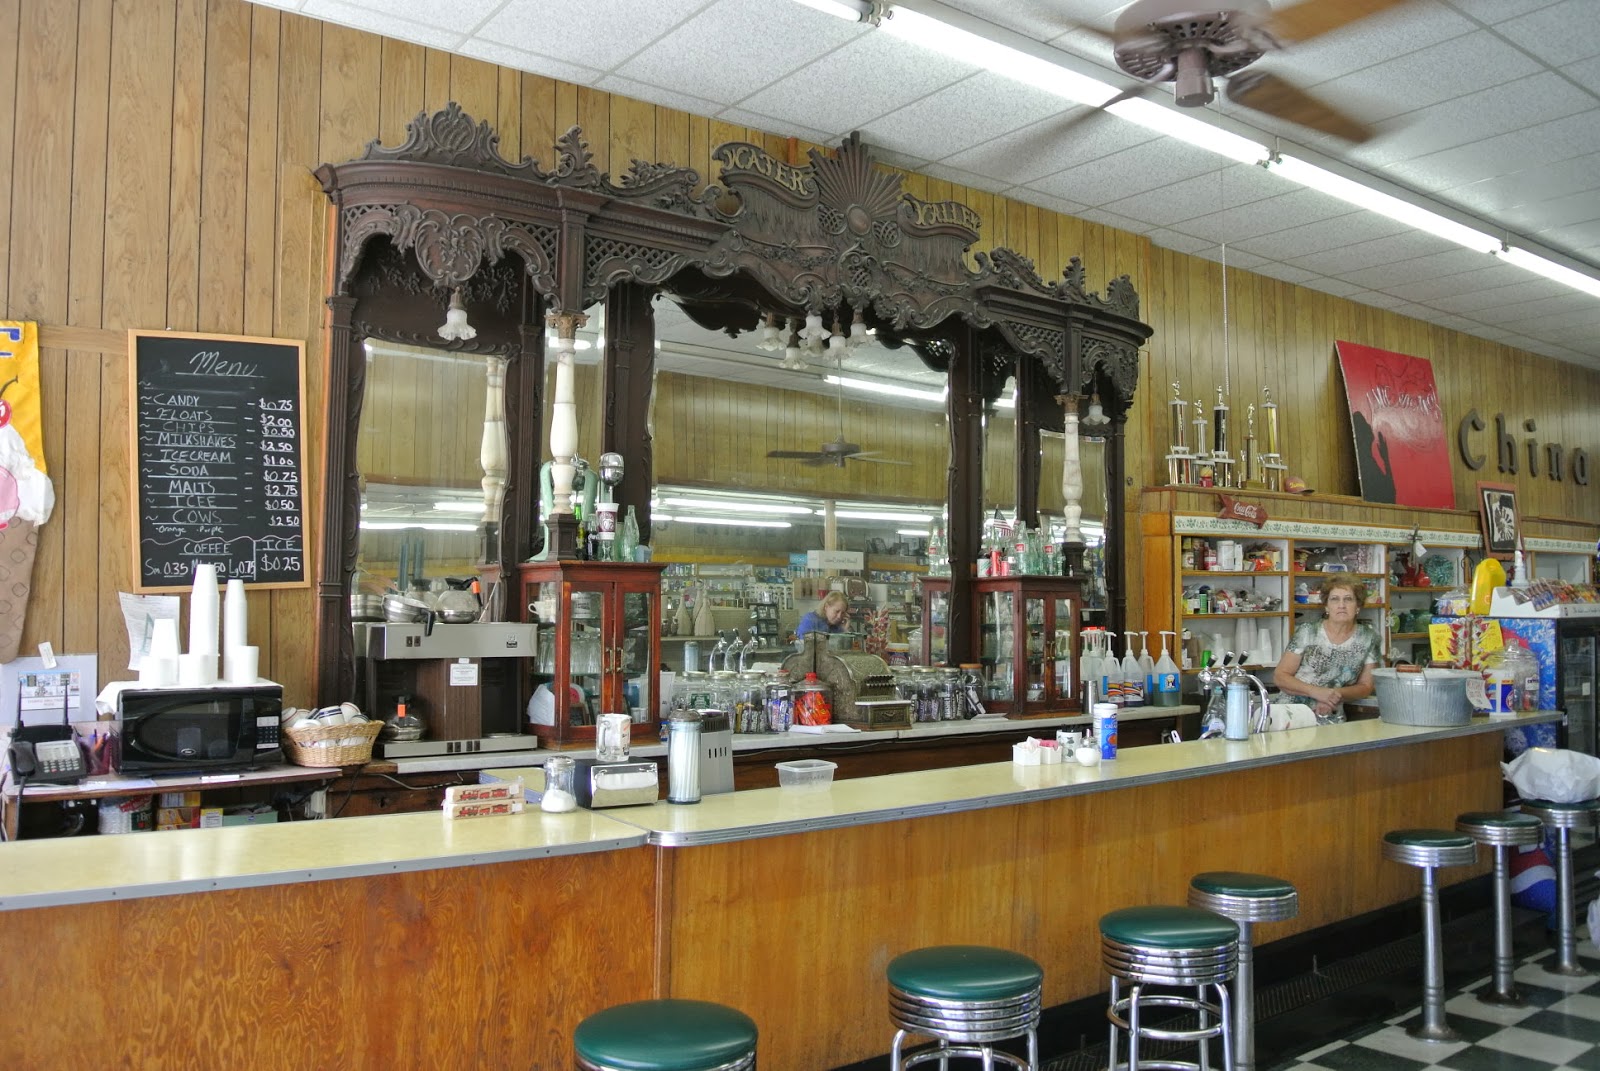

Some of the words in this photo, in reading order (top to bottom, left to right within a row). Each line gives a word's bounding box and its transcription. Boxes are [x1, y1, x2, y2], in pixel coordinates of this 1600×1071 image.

[723, 147, 808, 196] WATER
[914, 201, 982, 232] VALLEY
[189, 351, 258, 377] Menu
[153, 393, 200, 407] CANDY
[156, 407, 213, 422] FLOATS
[163, 421, 215, 434] CHIPS
[261, 426, 295, 437] $0.50
[157, 432, 236, 447] MILKSHAKES
[1458, 408, 1590, 486] China
[166, 464, 209, 476] SODA
[168, 480, 216, 494] MALTS
[169, 495, 217, 507] ICEE
[172, 509, 223, 524] COWS
[183, 542, 232, 554] COFFEE
[262, 540, 296, 551] ICE
[164, 562, 189, 575] 0.35
[260, 554, 300, 572] $0.25
